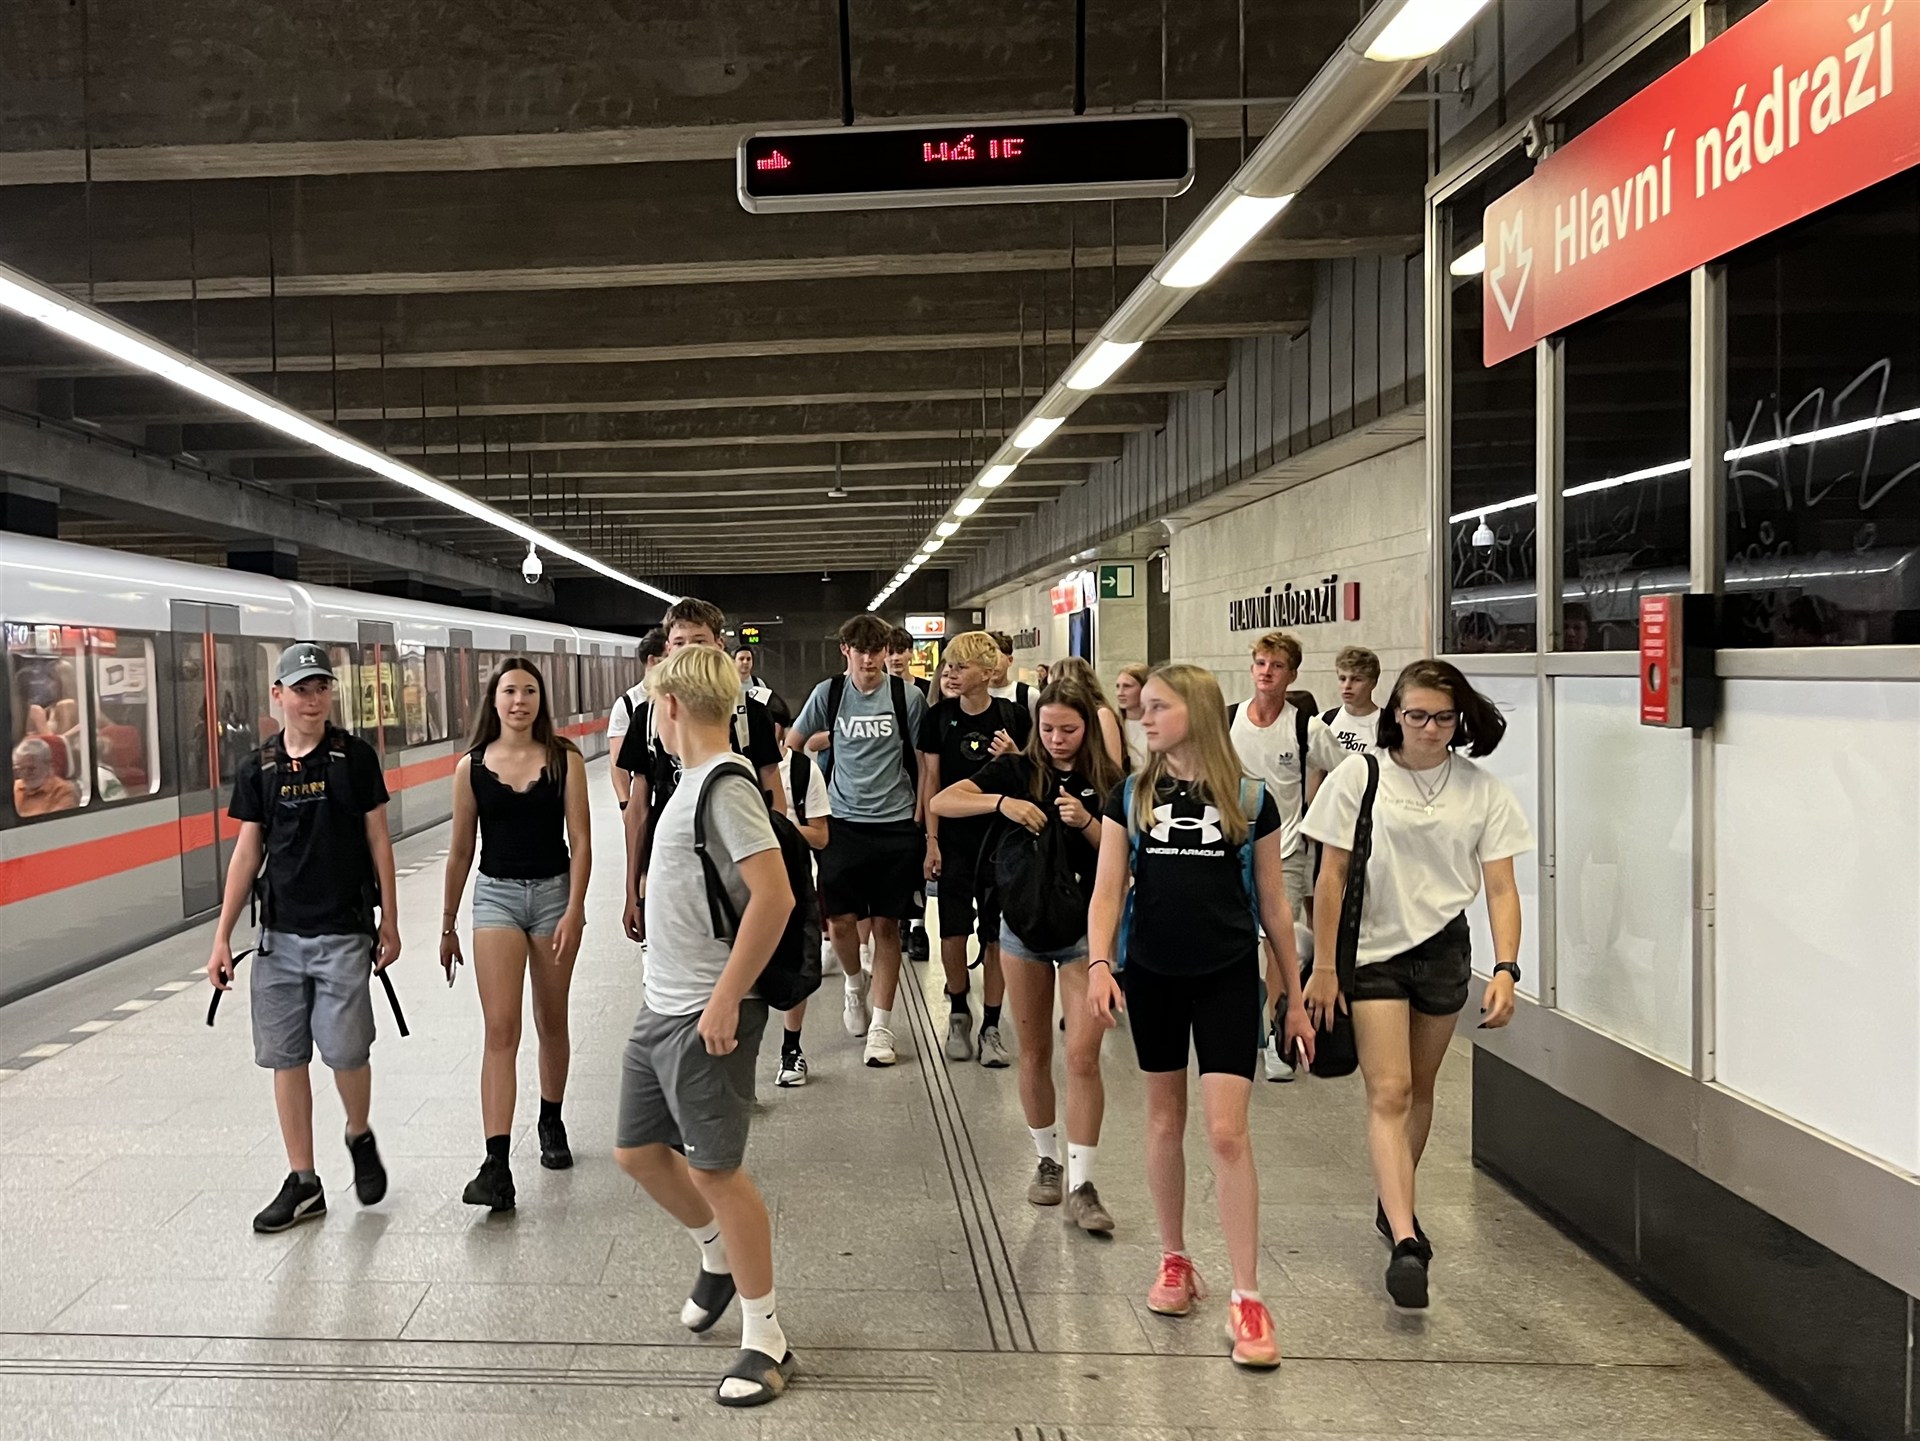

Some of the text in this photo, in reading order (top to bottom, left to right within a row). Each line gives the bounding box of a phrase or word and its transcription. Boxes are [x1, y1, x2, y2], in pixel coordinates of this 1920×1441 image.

[1553, 0, 1895, 274] Hlavní nádraží
[1229, 574, 1338, 632] HLAVNÍ NÁDRAŽÍ
[838, 714, 893, 738] VANS
[1336, 731, 1357, 740] JUST
[1345, 741, 1368, 752] DO IT
[1145, 847, 1225, 857] UNDER ARMOUR
